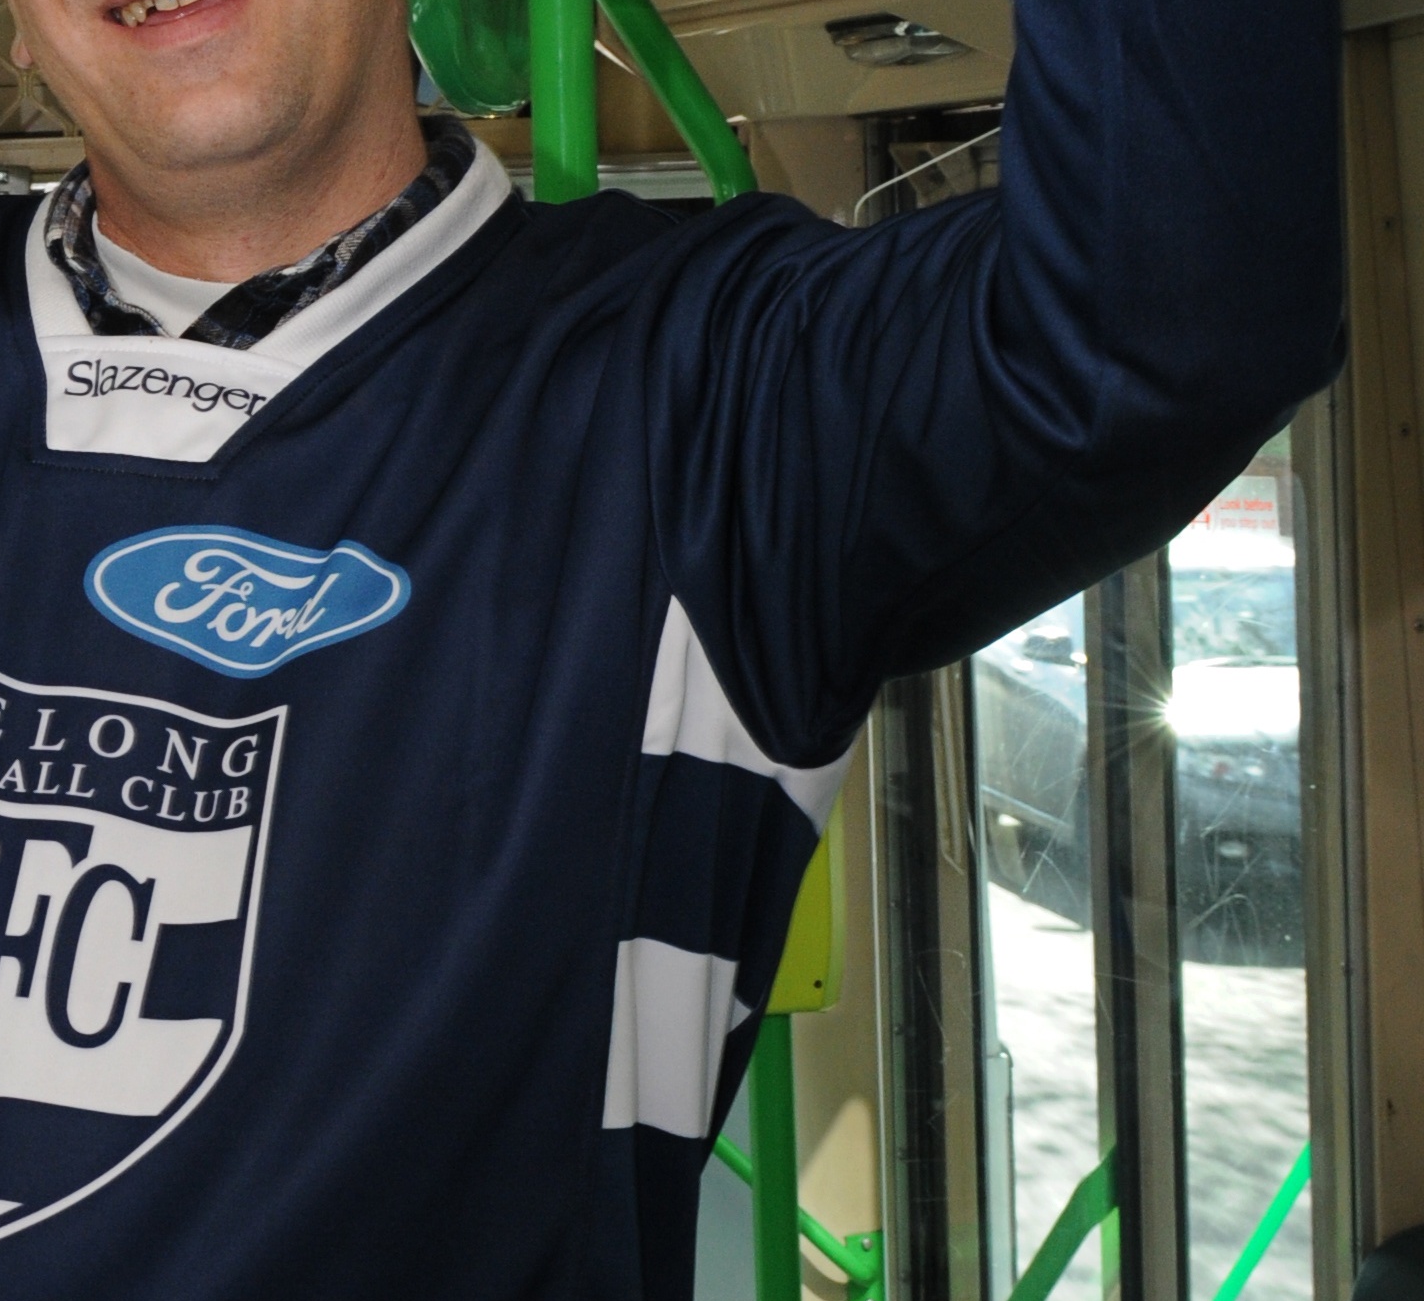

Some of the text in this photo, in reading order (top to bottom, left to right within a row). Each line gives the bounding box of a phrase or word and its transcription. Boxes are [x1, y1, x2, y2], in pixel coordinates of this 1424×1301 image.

[64, 359, 267, 416] Slazenger
[154, 548, 340, 648] Ford
[120, 775, 250, 823] CLUB
